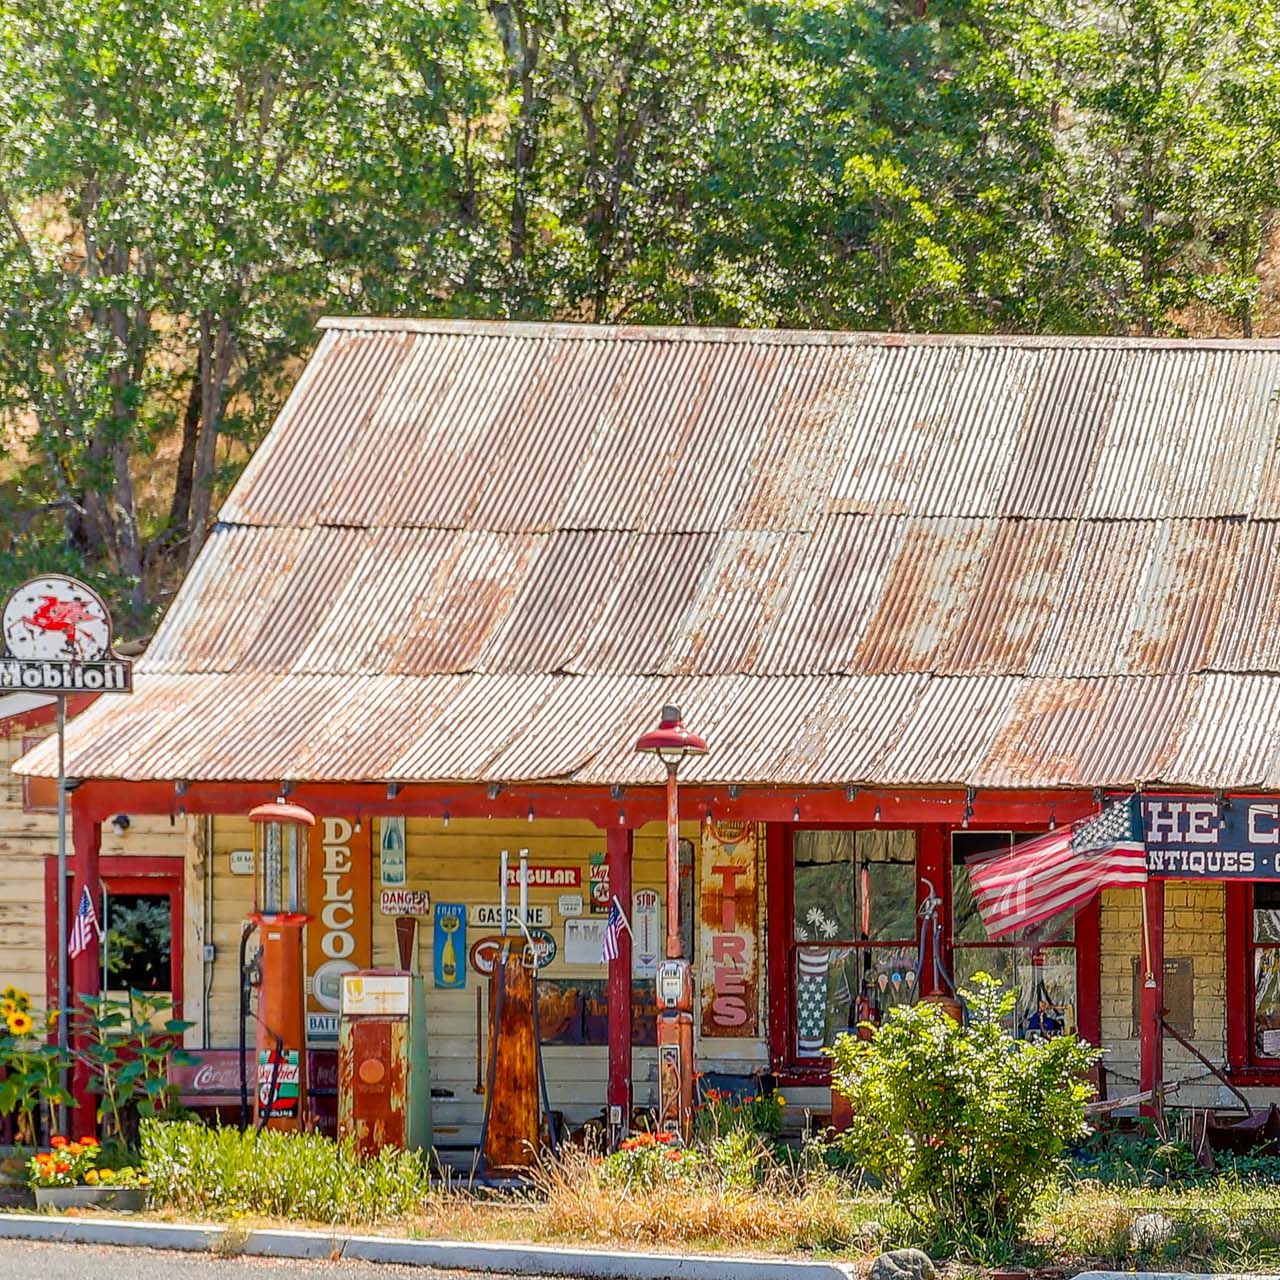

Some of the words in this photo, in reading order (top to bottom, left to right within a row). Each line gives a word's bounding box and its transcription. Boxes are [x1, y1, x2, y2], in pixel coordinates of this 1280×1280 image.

[0, 662, 124, 688] Mobiloil
[1141, 802, 1218, 842] HE
[1146, 851, 1255, 873] NTIQUES
[321, 817, 355, 958] DELCO
[382, 892, 425, 904] DANGER
[637, 894, 656, 906] STOP
[437, 906, 462, 915] ENJOY
[478, 907, 543, 923] GASONE
[712, 865, 747, 1026] TIRES
[274, 1065, 298, 1080] hief
